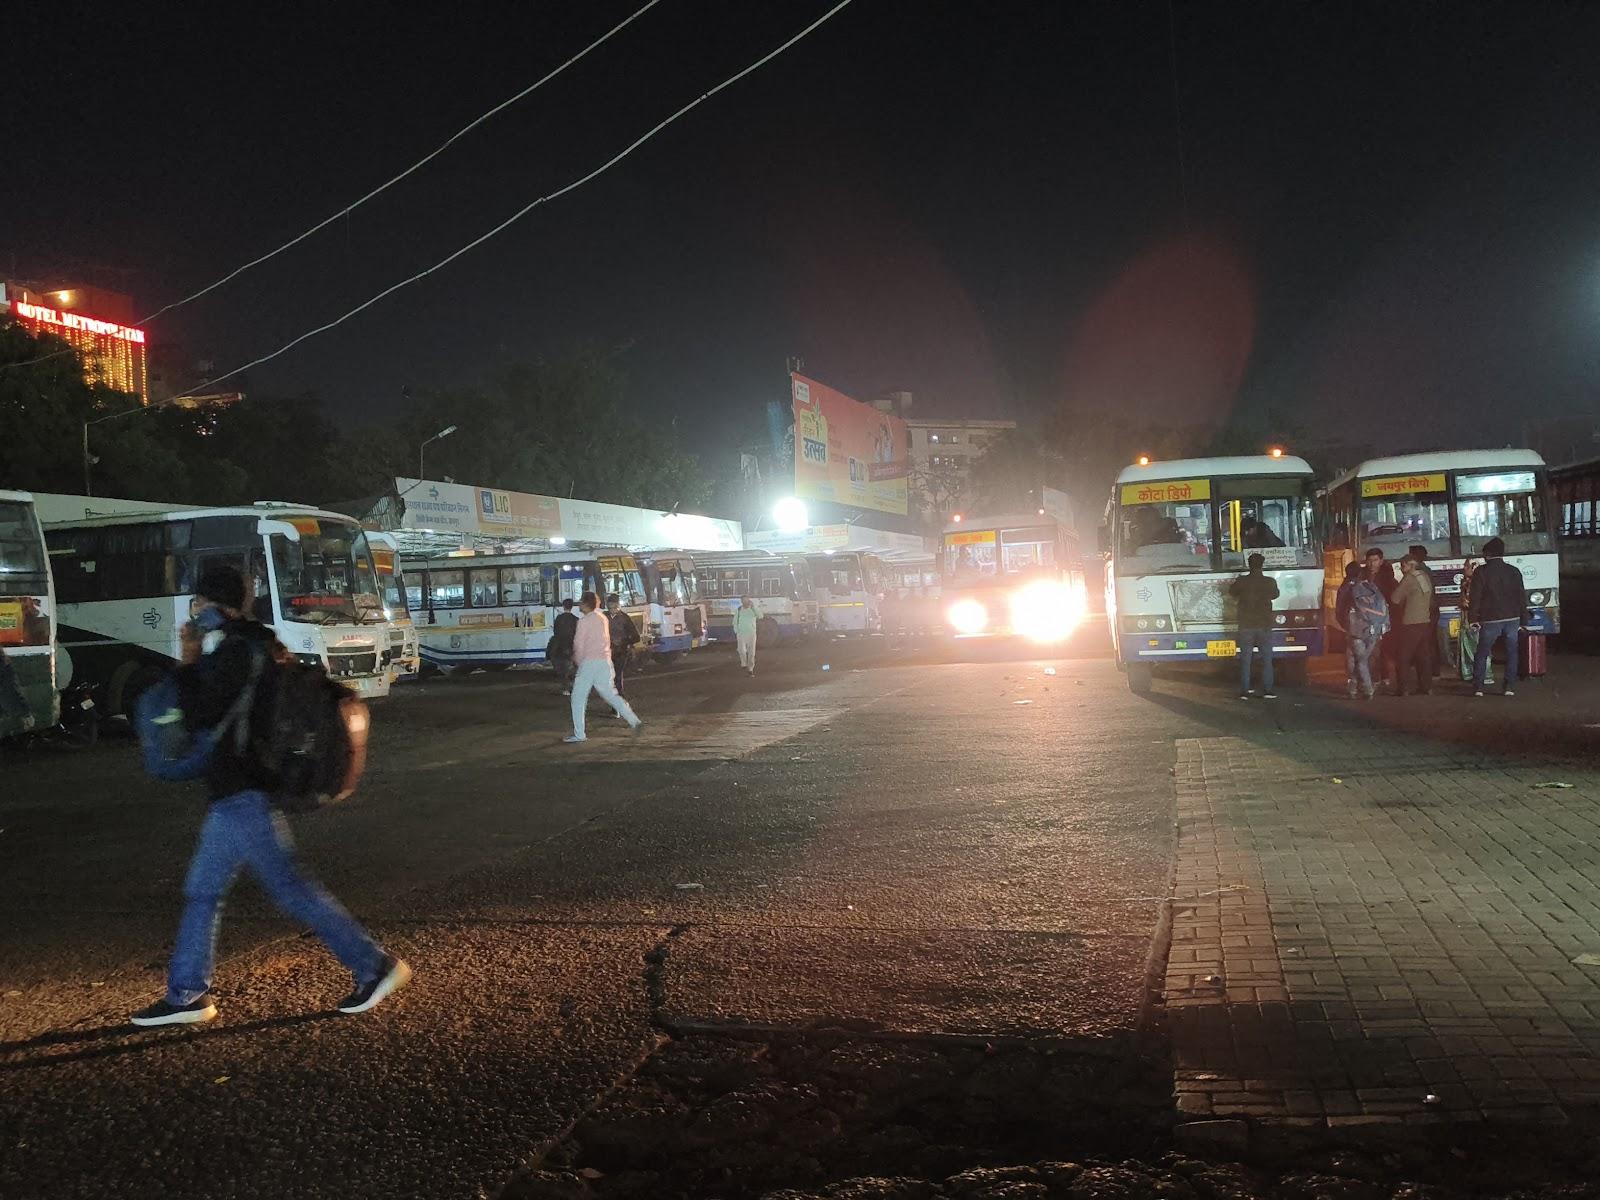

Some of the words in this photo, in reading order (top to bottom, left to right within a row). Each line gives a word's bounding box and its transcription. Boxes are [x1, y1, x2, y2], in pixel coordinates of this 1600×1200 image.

[17, 302, 61, 325] HOTEL
[62, 311, 145, 343] METROPOLITAN
[1138, 487, 1165, 501] कोटा
[1167, 483, 1192, 500] डिपो
[1376, 480, 1406, 493] जयपुर
[494, 494, 509, 513] LIC
